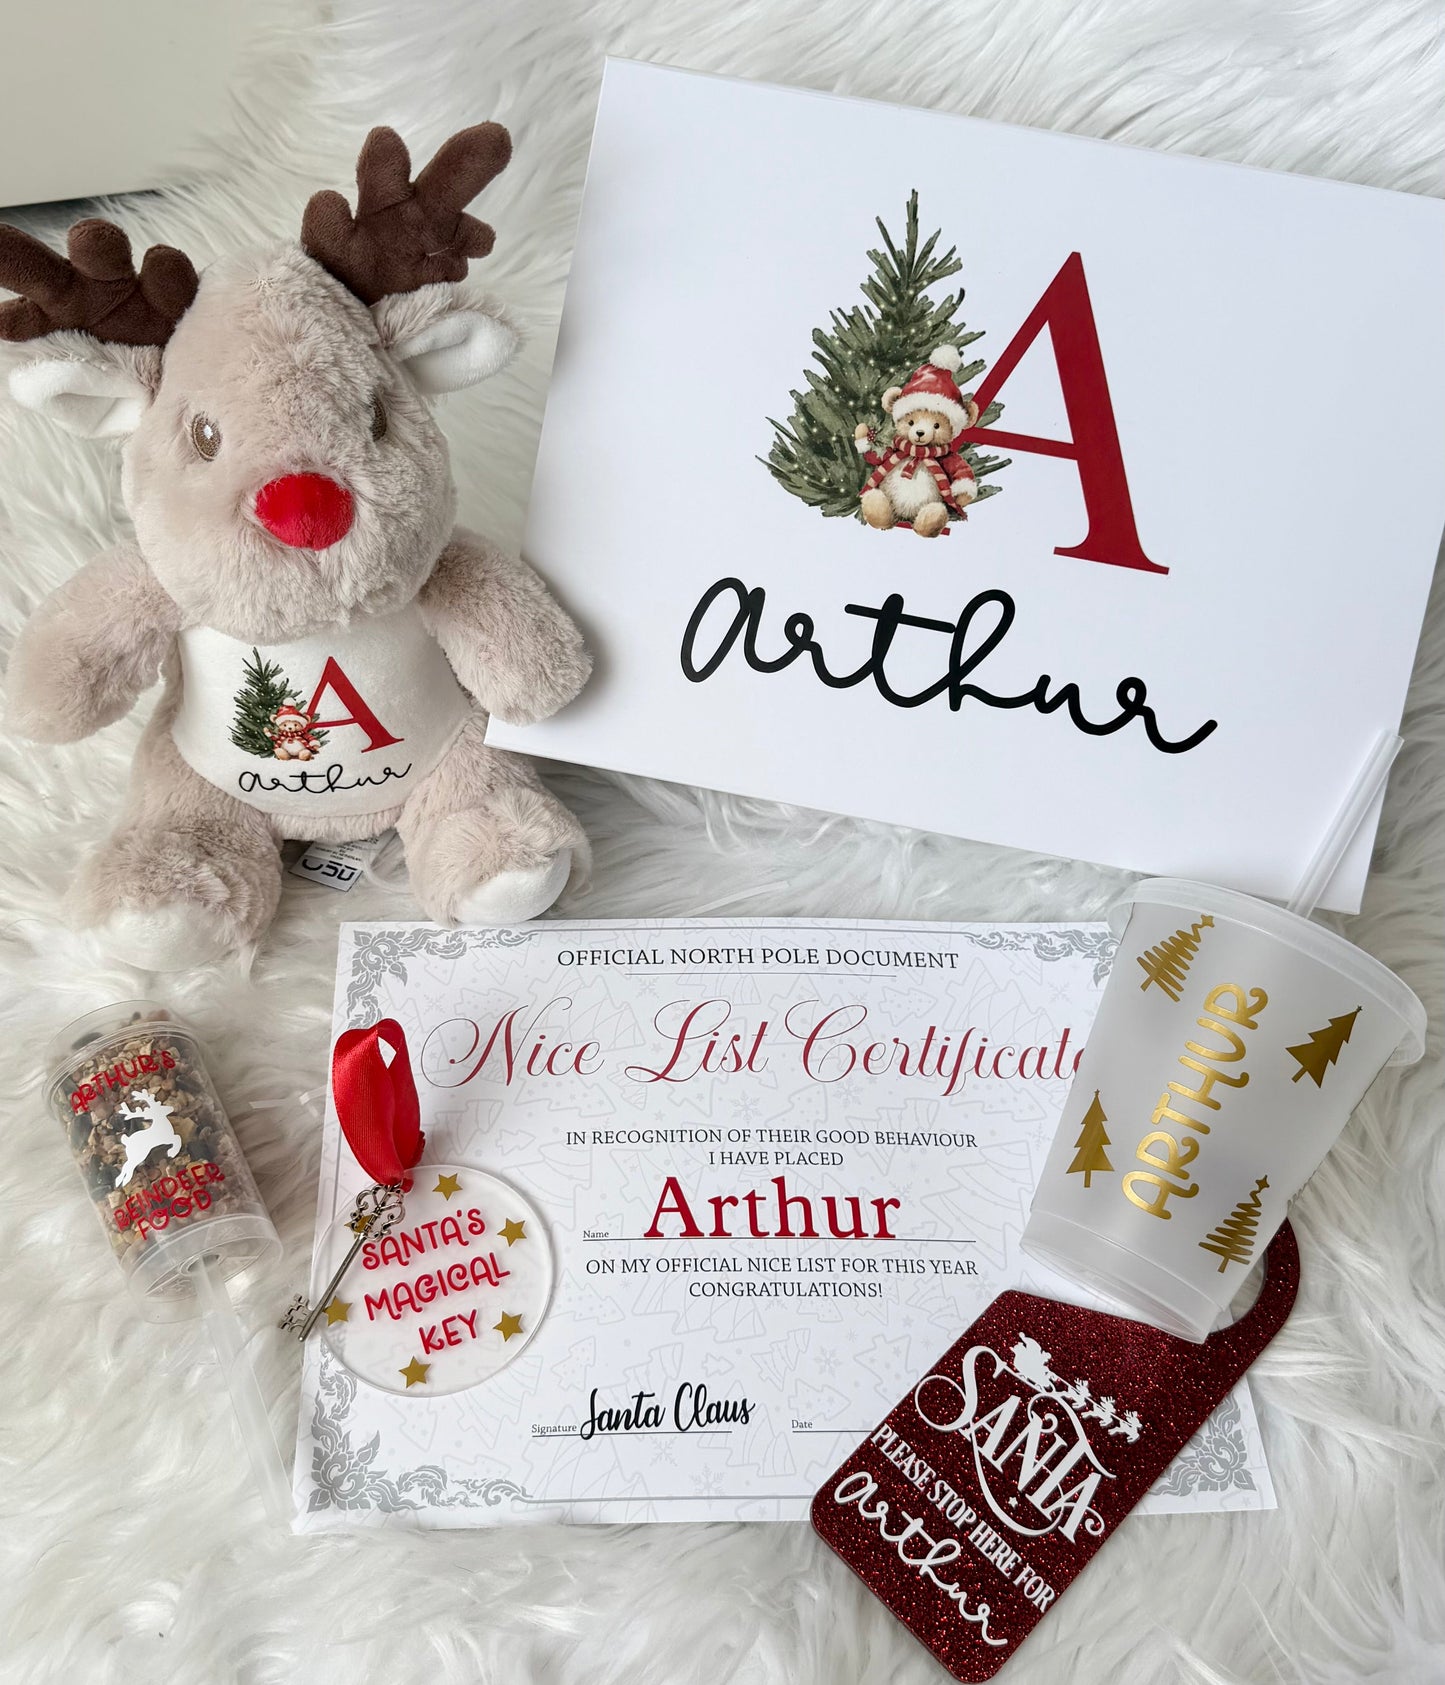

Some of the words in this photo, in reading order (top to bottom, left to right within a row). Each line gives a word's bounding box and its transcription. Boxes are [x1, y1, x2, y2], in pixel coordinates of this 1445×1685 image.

[951, 252, 1169, 576] A
[306, 655, 405, 754] A
[557, 948, 665, 967] OFFICIAL
[670, 948, 755, 965] NORTH
[761, 947, 820, 965] POLE
[826, 949, 959, 969] DOCUMENT
[421, 996, 605, 1088] Nice
[624, 999, 769, 1083] List
[70, 1049, 177, 1116] ARTHUR'S
[1121, 982, 1270, 1221] ARTHUR
[566, 1131, 587, 1145] IN
[592, 1129, 722, 1145] RECOGNITION
[727, 1128, 751, 1143] OF
[755, 1129, 813, 1143] THEIR
[815, 1129, 870, 1144] GOOD
[874, 1131, 978, 1148] BEHAVIOUR
[708, 1151, 715, 1165] I
[720, 1151, 770, 1165] HAVE
[774, 1151, 844, 1166] PLACED
[113, 1162, 226, 1232] REINDEER
[136, 1188, 213, 1241] FOOD
[582, 1229, 610, 1239] Name
[643, 1176, 901, 1239] Arthur
[362, 1208, 487, 1271] SANTA'S
[586, 1259, 615, 1275] ON
[621, 1258, 651, 1274] MY
[655, 1257, 743, 1273] OFFICIAL
[747, 1257, 792, 1273] NICE
[797, 1257, 836, 1273] LIST
[840, 1257, 879, 1273] FOR
[882, 1258, 926, 1274] THIS
[929, 1259, 979, 1276] YEAR
[363, 1252, 512, 1322] MAGICAL
[689, 1281, 883, 1298] CONGRATULATIONS!
[417, 1308, 480, 1356] KEY
[531, 1422, 578, 1435] Signature
[580, 1388, 666, 1441] Santa
[674, 1382, 757, 1433] Claus
[791, 1418, 814, 1430] Date
[915, 1345, 1117, 1545] SANTA
[869, 1423, 938, 1492] PLEASE
[926, 1479, 978, 1530] STOP
[966, 1519, 1023, 1578] HERE
[1012, 1564, 1056, 1613] FOR
